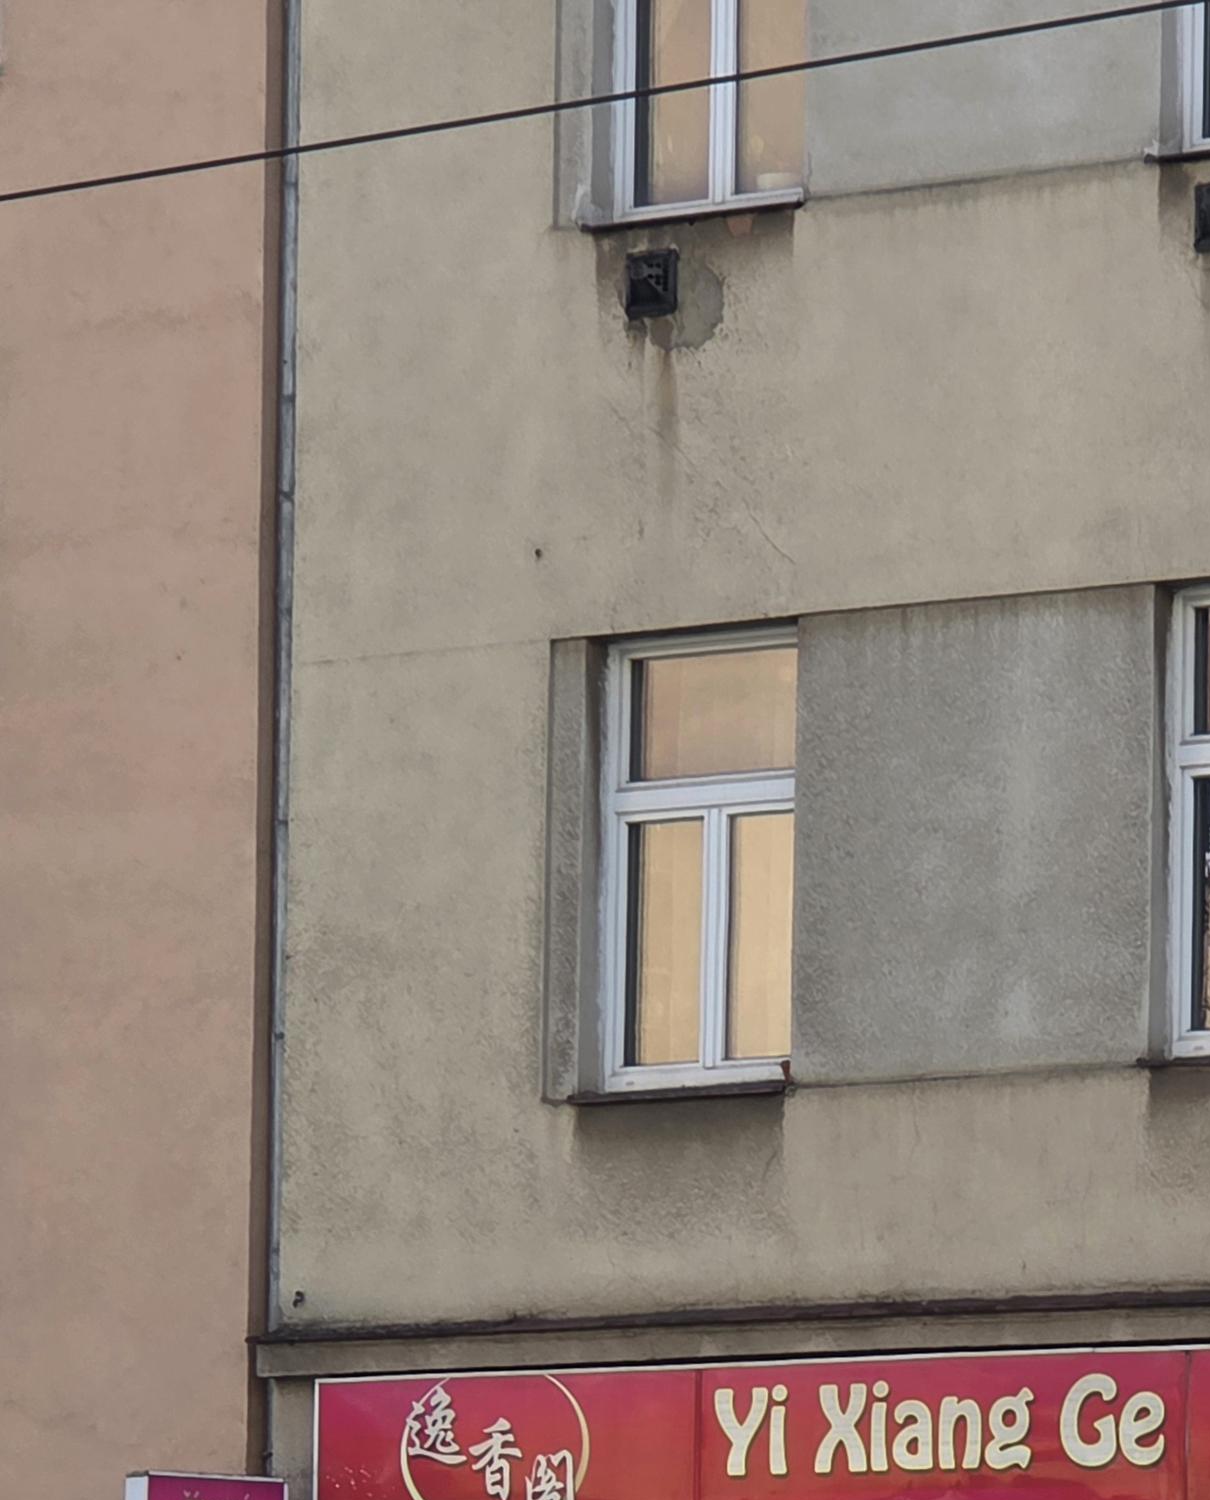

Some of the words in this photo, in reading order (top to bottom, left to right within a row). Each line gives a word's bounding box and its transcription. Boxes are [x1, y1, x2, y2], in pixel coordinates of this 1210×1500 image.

[713, 1383, 789, 1477] Yi
[813, 1380, 1034, 1474] Xiang
[1059, 1372, 1166, 1468] Ge
